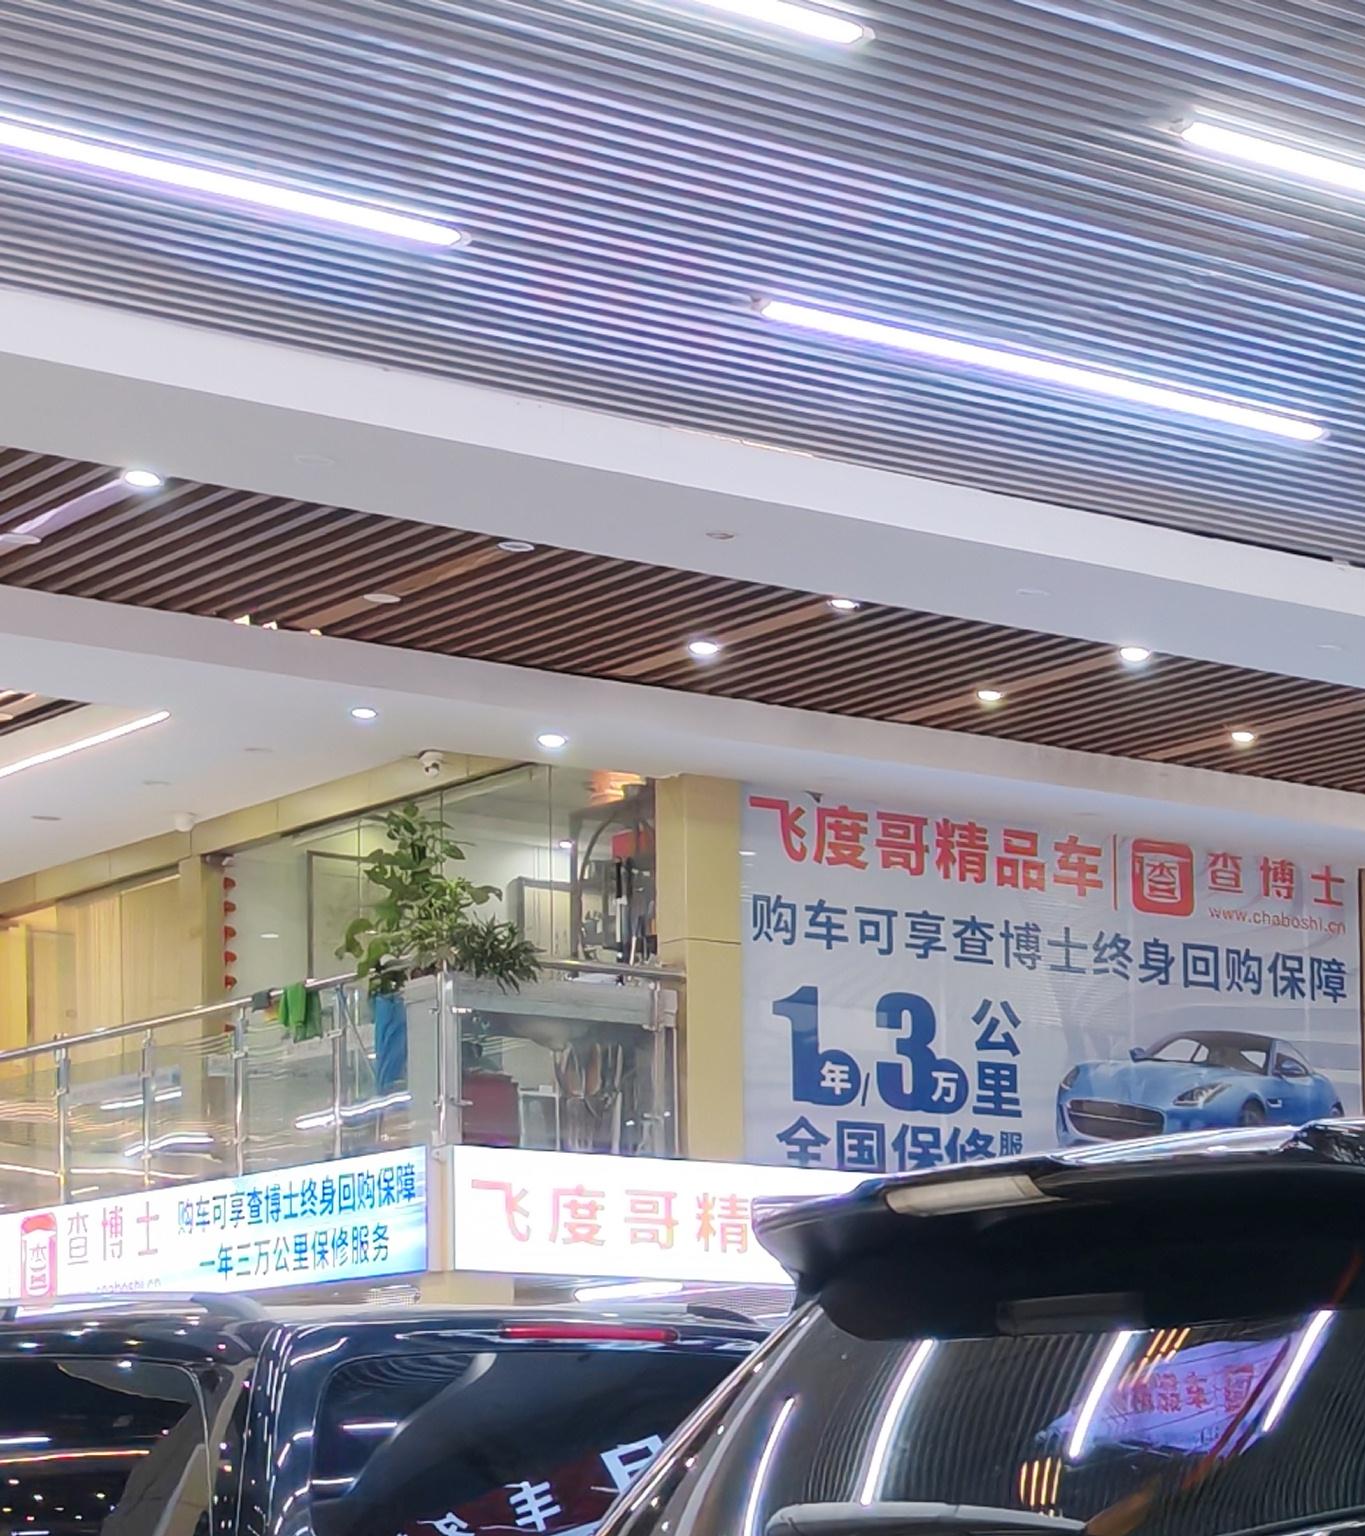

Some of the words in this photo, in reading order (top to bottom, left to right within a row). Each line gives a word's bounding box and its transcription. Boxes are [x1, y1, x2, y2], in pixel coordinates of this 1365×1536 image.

[748, 795, 1104, 897] 飞度哥精品车
[1207, 851, 1346, 907] 查博士
[751, 894, 1348, 1003] 购车可享查博士终身回购保障
[1207, 907, 1347, 935] www.chaboshi.cn
[66, 1201, 161, 1267] 查博士
[199, 1223, 391, 1281] 一年三万公里保修服务
